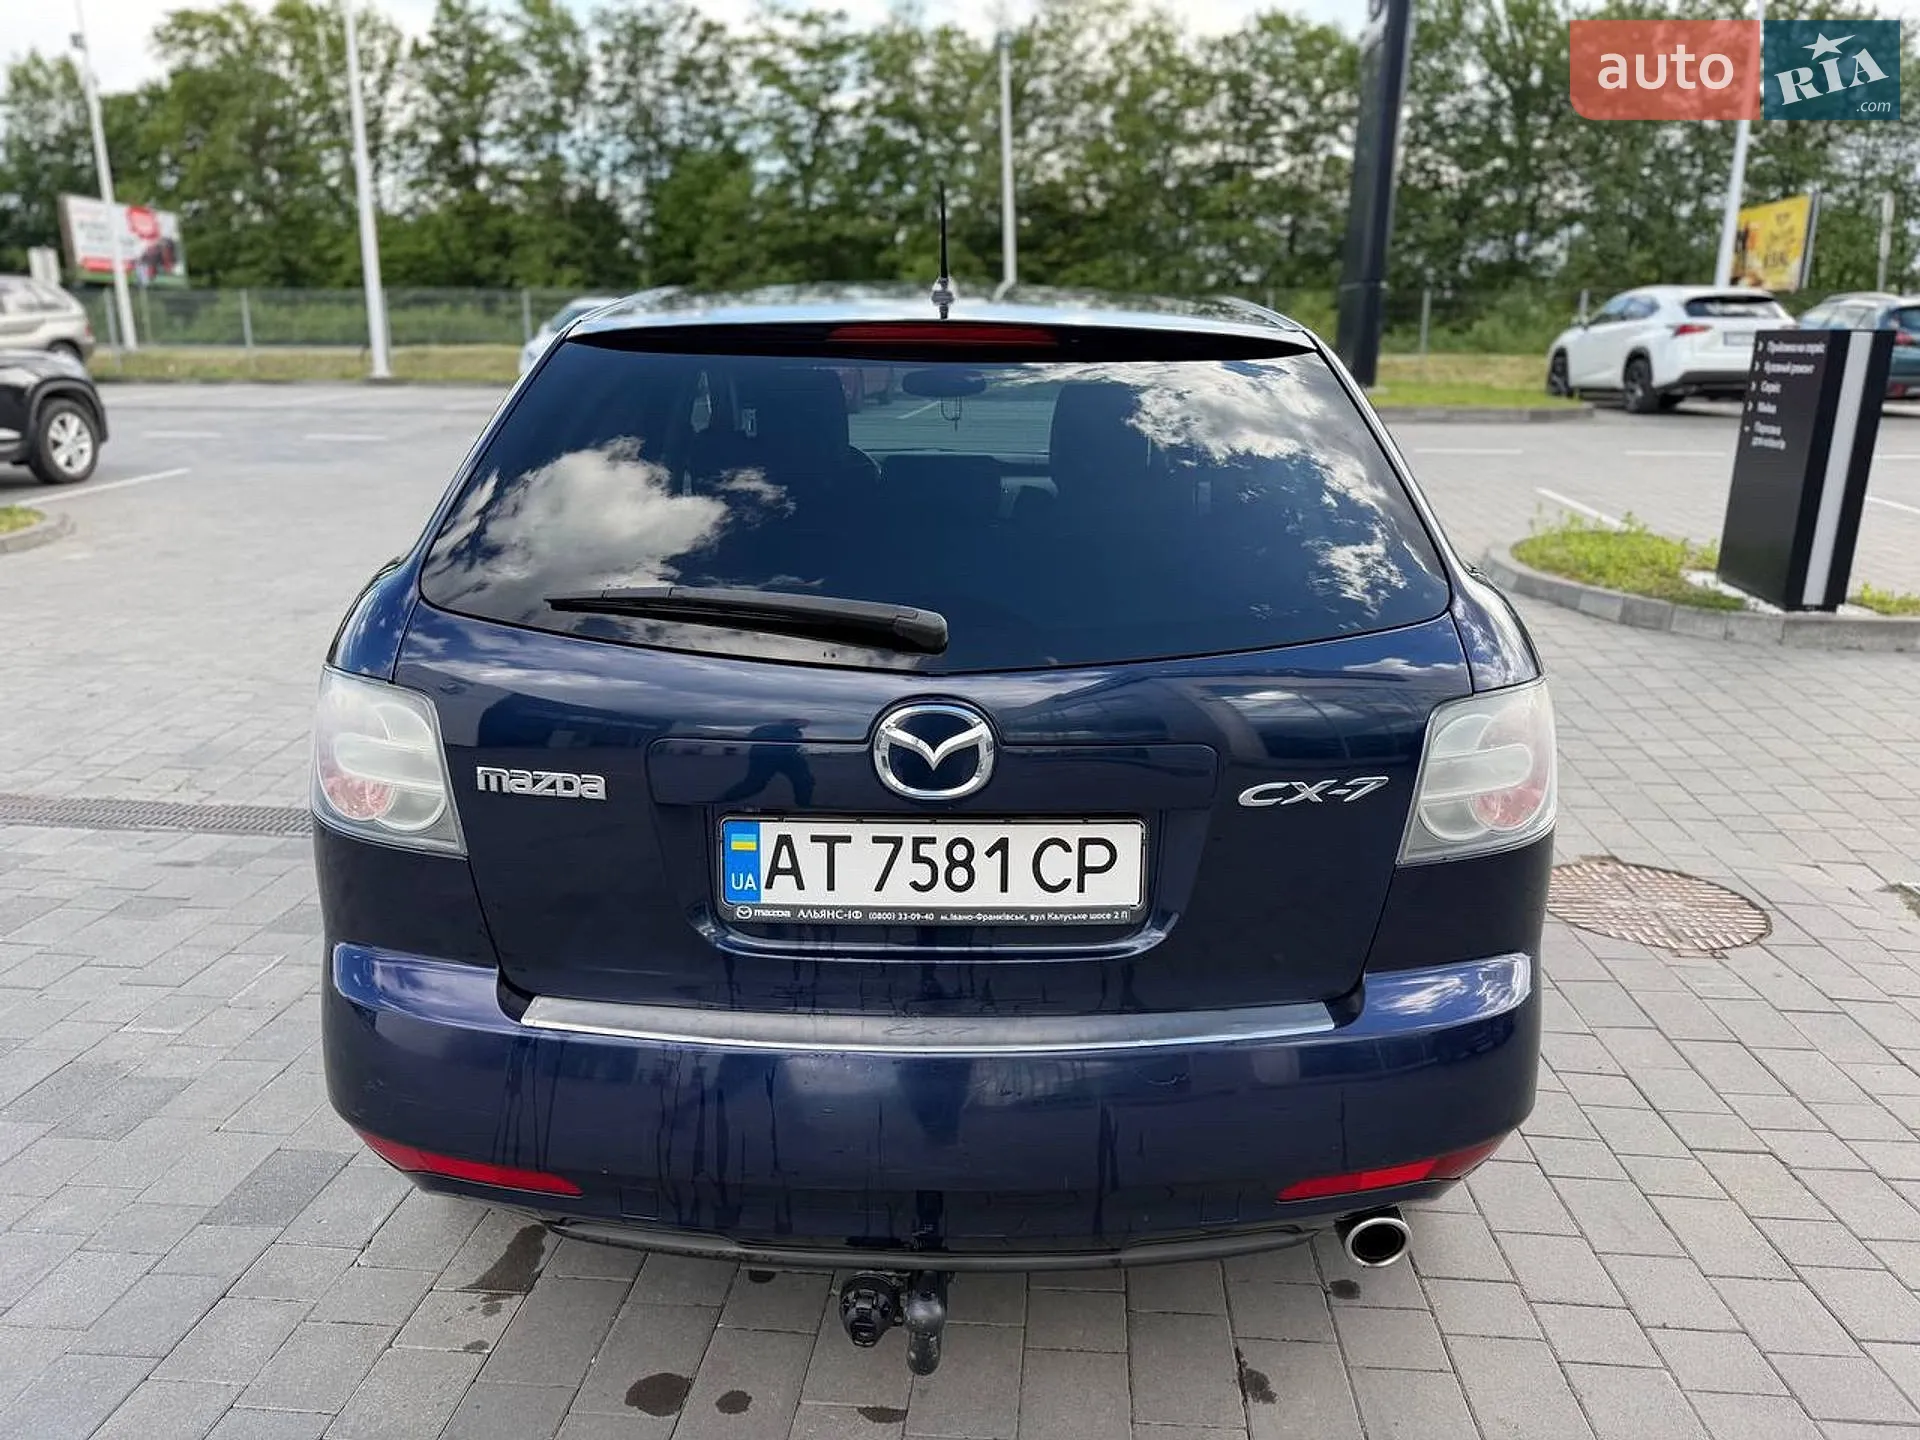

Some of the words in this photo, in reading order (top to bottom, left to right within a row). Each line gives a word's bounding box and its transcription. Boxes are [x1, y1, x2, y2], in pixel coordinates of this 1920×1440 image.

[1238, 776, 1389, 807] CX-7
[764, 834, 852, 892] AT
[871, 835, 1009, 894] 7581
[1031, 836, 1118, 894] CP
[731, 873, 757, 891] UA
[868, 912, 896, 921] (0800)
[1113, 911, 1120, 919] 2
